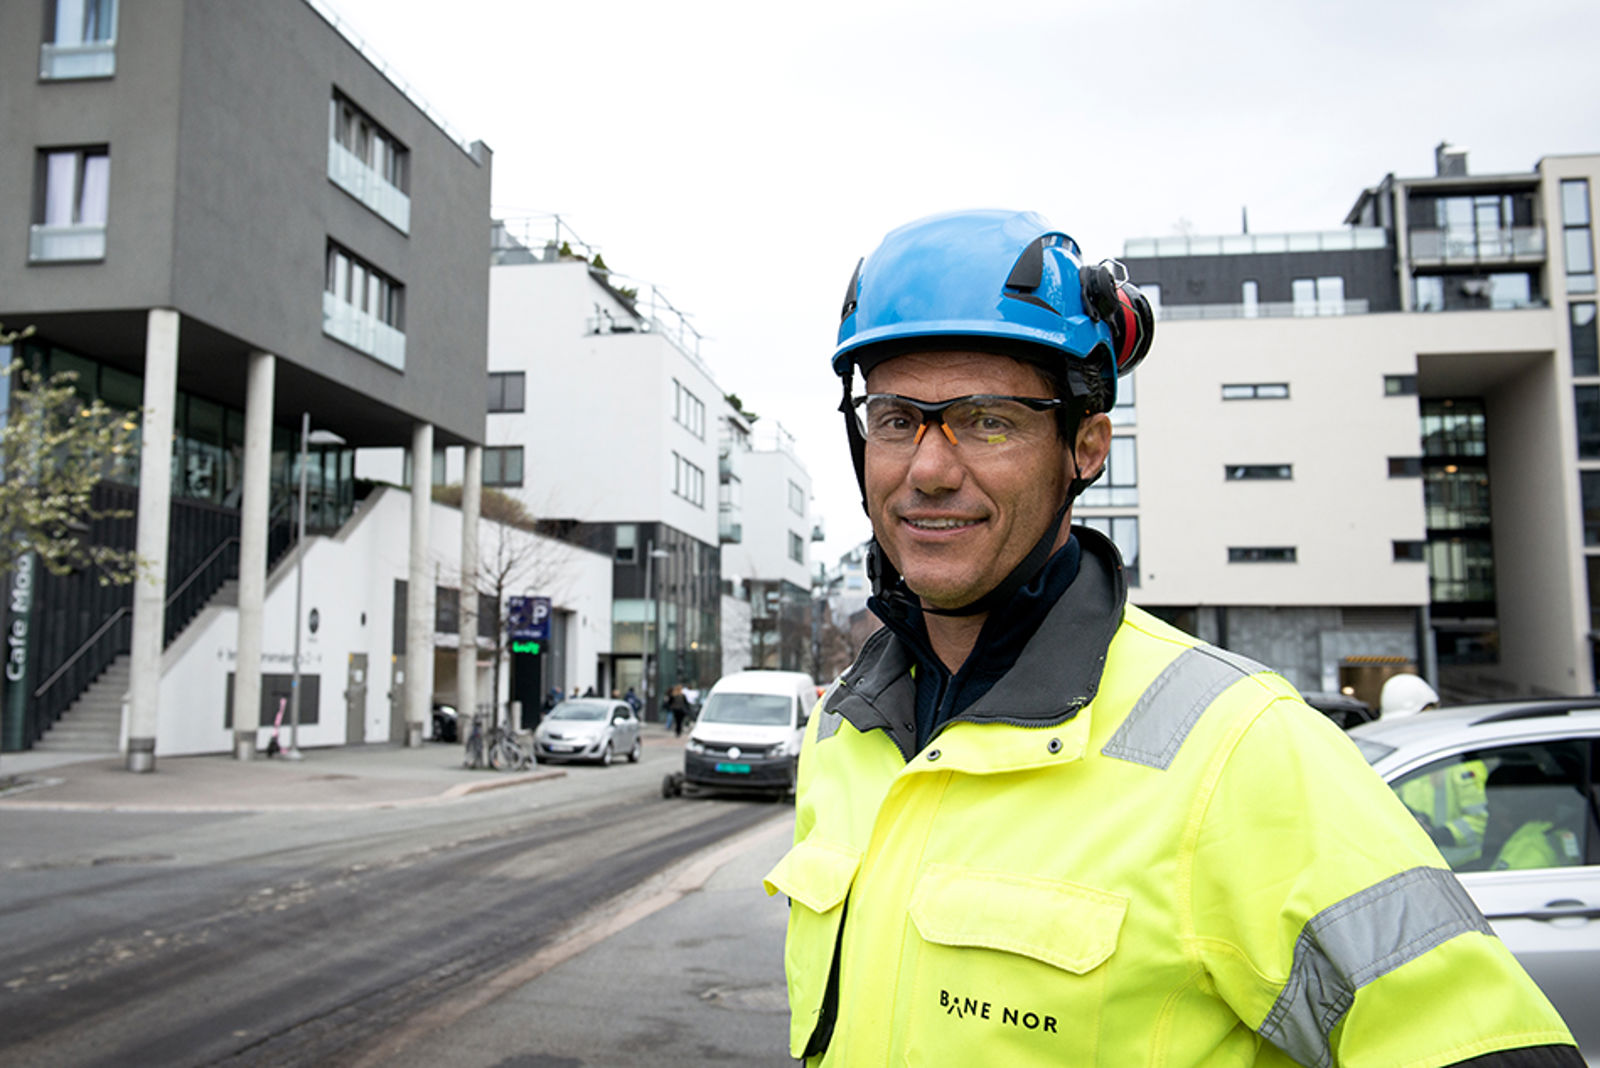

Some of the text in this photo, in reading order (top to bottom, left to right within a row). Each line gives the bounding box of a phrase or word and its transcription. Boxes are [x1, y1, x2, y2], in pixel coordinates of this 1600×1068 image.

[532, 604, 548, 625] P
[6, 618, 27, 681] Cafe
[940, 989, 1057, 1033] BANE NOR
